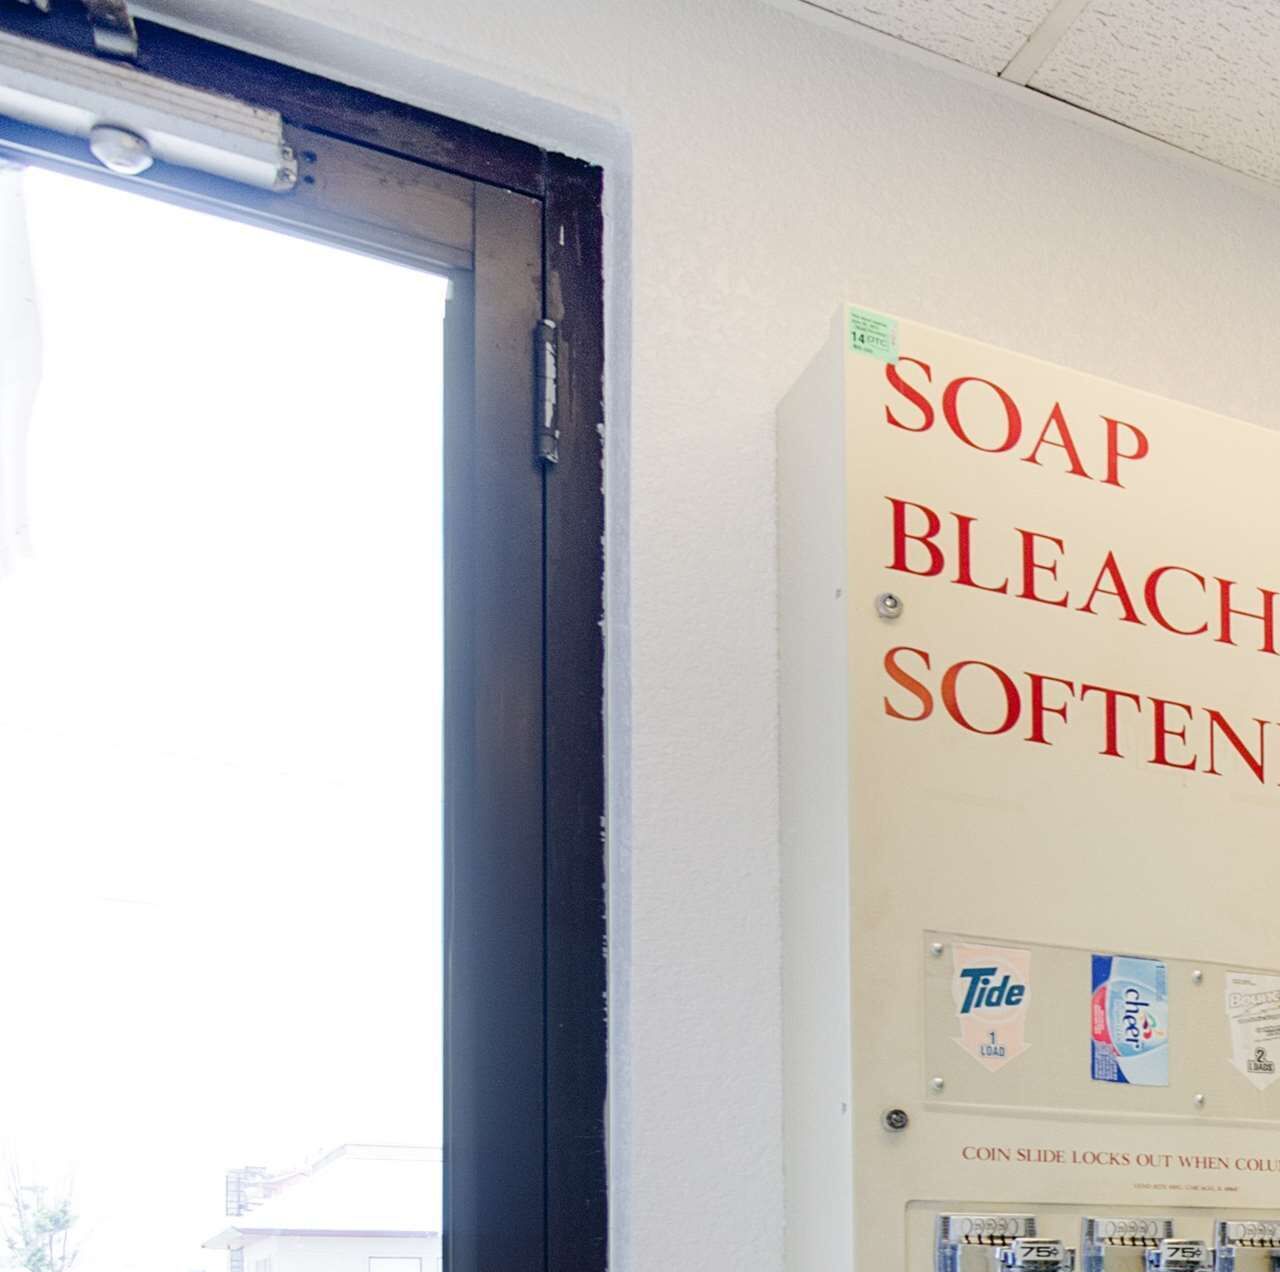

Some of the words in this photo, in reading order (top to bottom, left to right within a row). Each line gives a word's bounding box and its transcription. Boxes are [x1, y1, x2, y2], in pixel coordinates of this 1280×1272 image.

[884, 355, 1150, 490] SOAP
[884, 495, 1280, 657] BLEACH
[959, 966, 1026, 1015] Tide
[1122, 987, 1150, 1049] cheer
[988, 1031, 996, 1045] 1
[980, 1045, 1006, 1057] LOAD
[1256, 1049, 1266, 1062] 2
[962, 1146, 1012, 1162] COIN
[1016, 1148, 1065, 1164] SLIDE
[1071, 1150, 1131, 1166] LOCKS
[1136, 1153, 1173, 1168] OUT
[1178, 1155, 1230, 1170] WHEN
[1022, 1245, 1059, 1258] 75¢
[1167, 1246, 1202, 1260] 75¢
